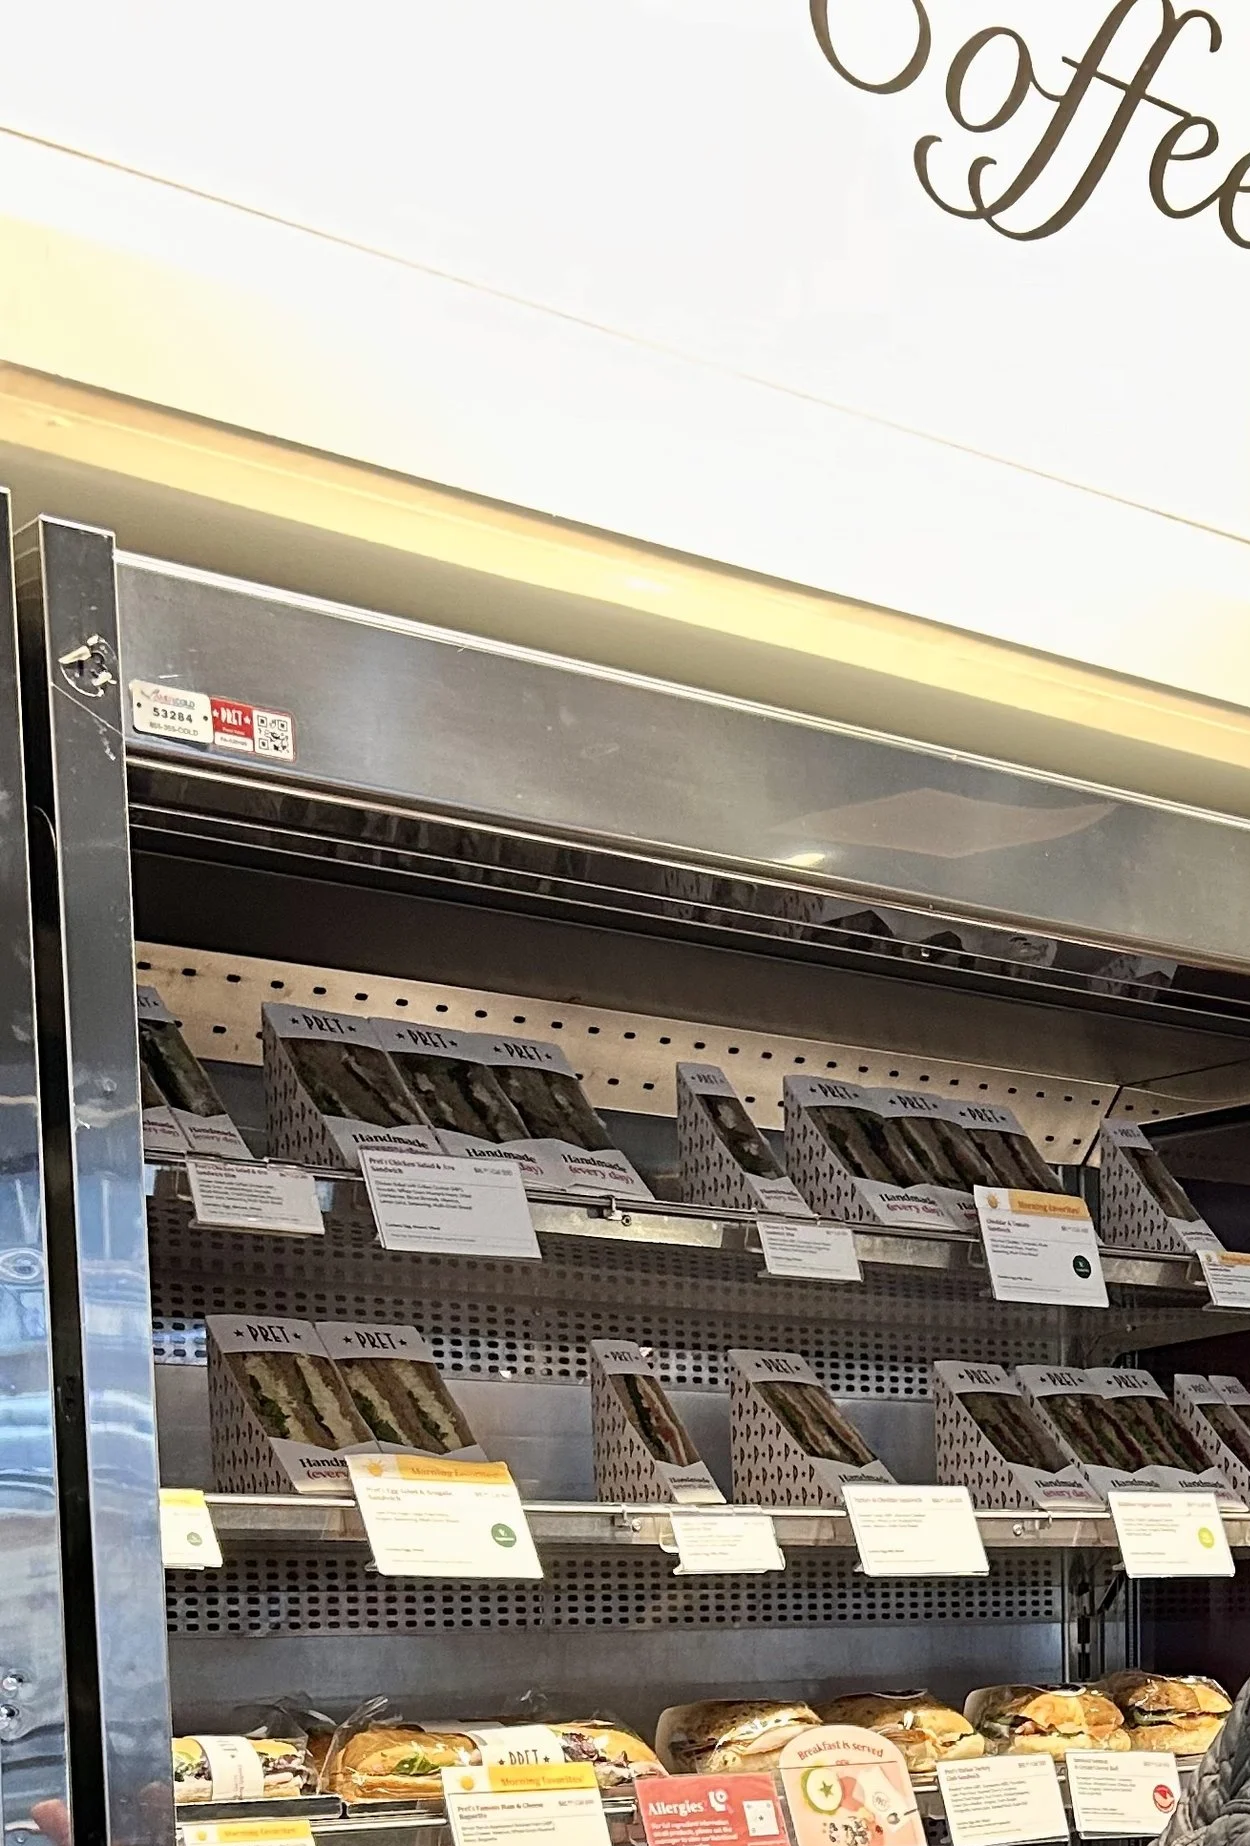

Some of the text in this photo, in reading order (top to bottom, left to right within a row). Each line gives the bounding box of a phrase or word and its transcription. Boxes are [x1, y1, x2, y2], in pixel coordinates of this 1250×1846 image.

[153, 707, 193, 723] 53284
[302, 1013, 345, 1036] PRET
[408, 1028, 446, 1050] PRET
[504, 1041, 541, 1063] PRET
[818, 1083, 852, 1100] PRET
[898, 1096, 929, 1111] PRET
[967, 1107, 998, 1123] PRET
[352, 1133, 429, 1150] Handmade
[465, 1148, 536, 1164] Handmade
[562, 1154, 628, 1174] Handmade
[569, 1164, 634, 1185] (every day)
[879, 1192, 938, 1206] Handmade
[247, 1324, 291, 1344] PRET
[357, 1331, 397, 1350] PRET
[610, 1351, 632, 1363] PRET
[763, 1358, 797, 1375] PRET
[965, 1368, 995, 1385] PRET
[1050, 1372, 1077, 1387] PRET
[1114, 1374, 1140, 1389] PRET
[1035, 1479, 1084, 1489] Handmade
[797, 1741, 884, 1760] Breakfast is served
[648, 1800, 704, 1817] Allergies
